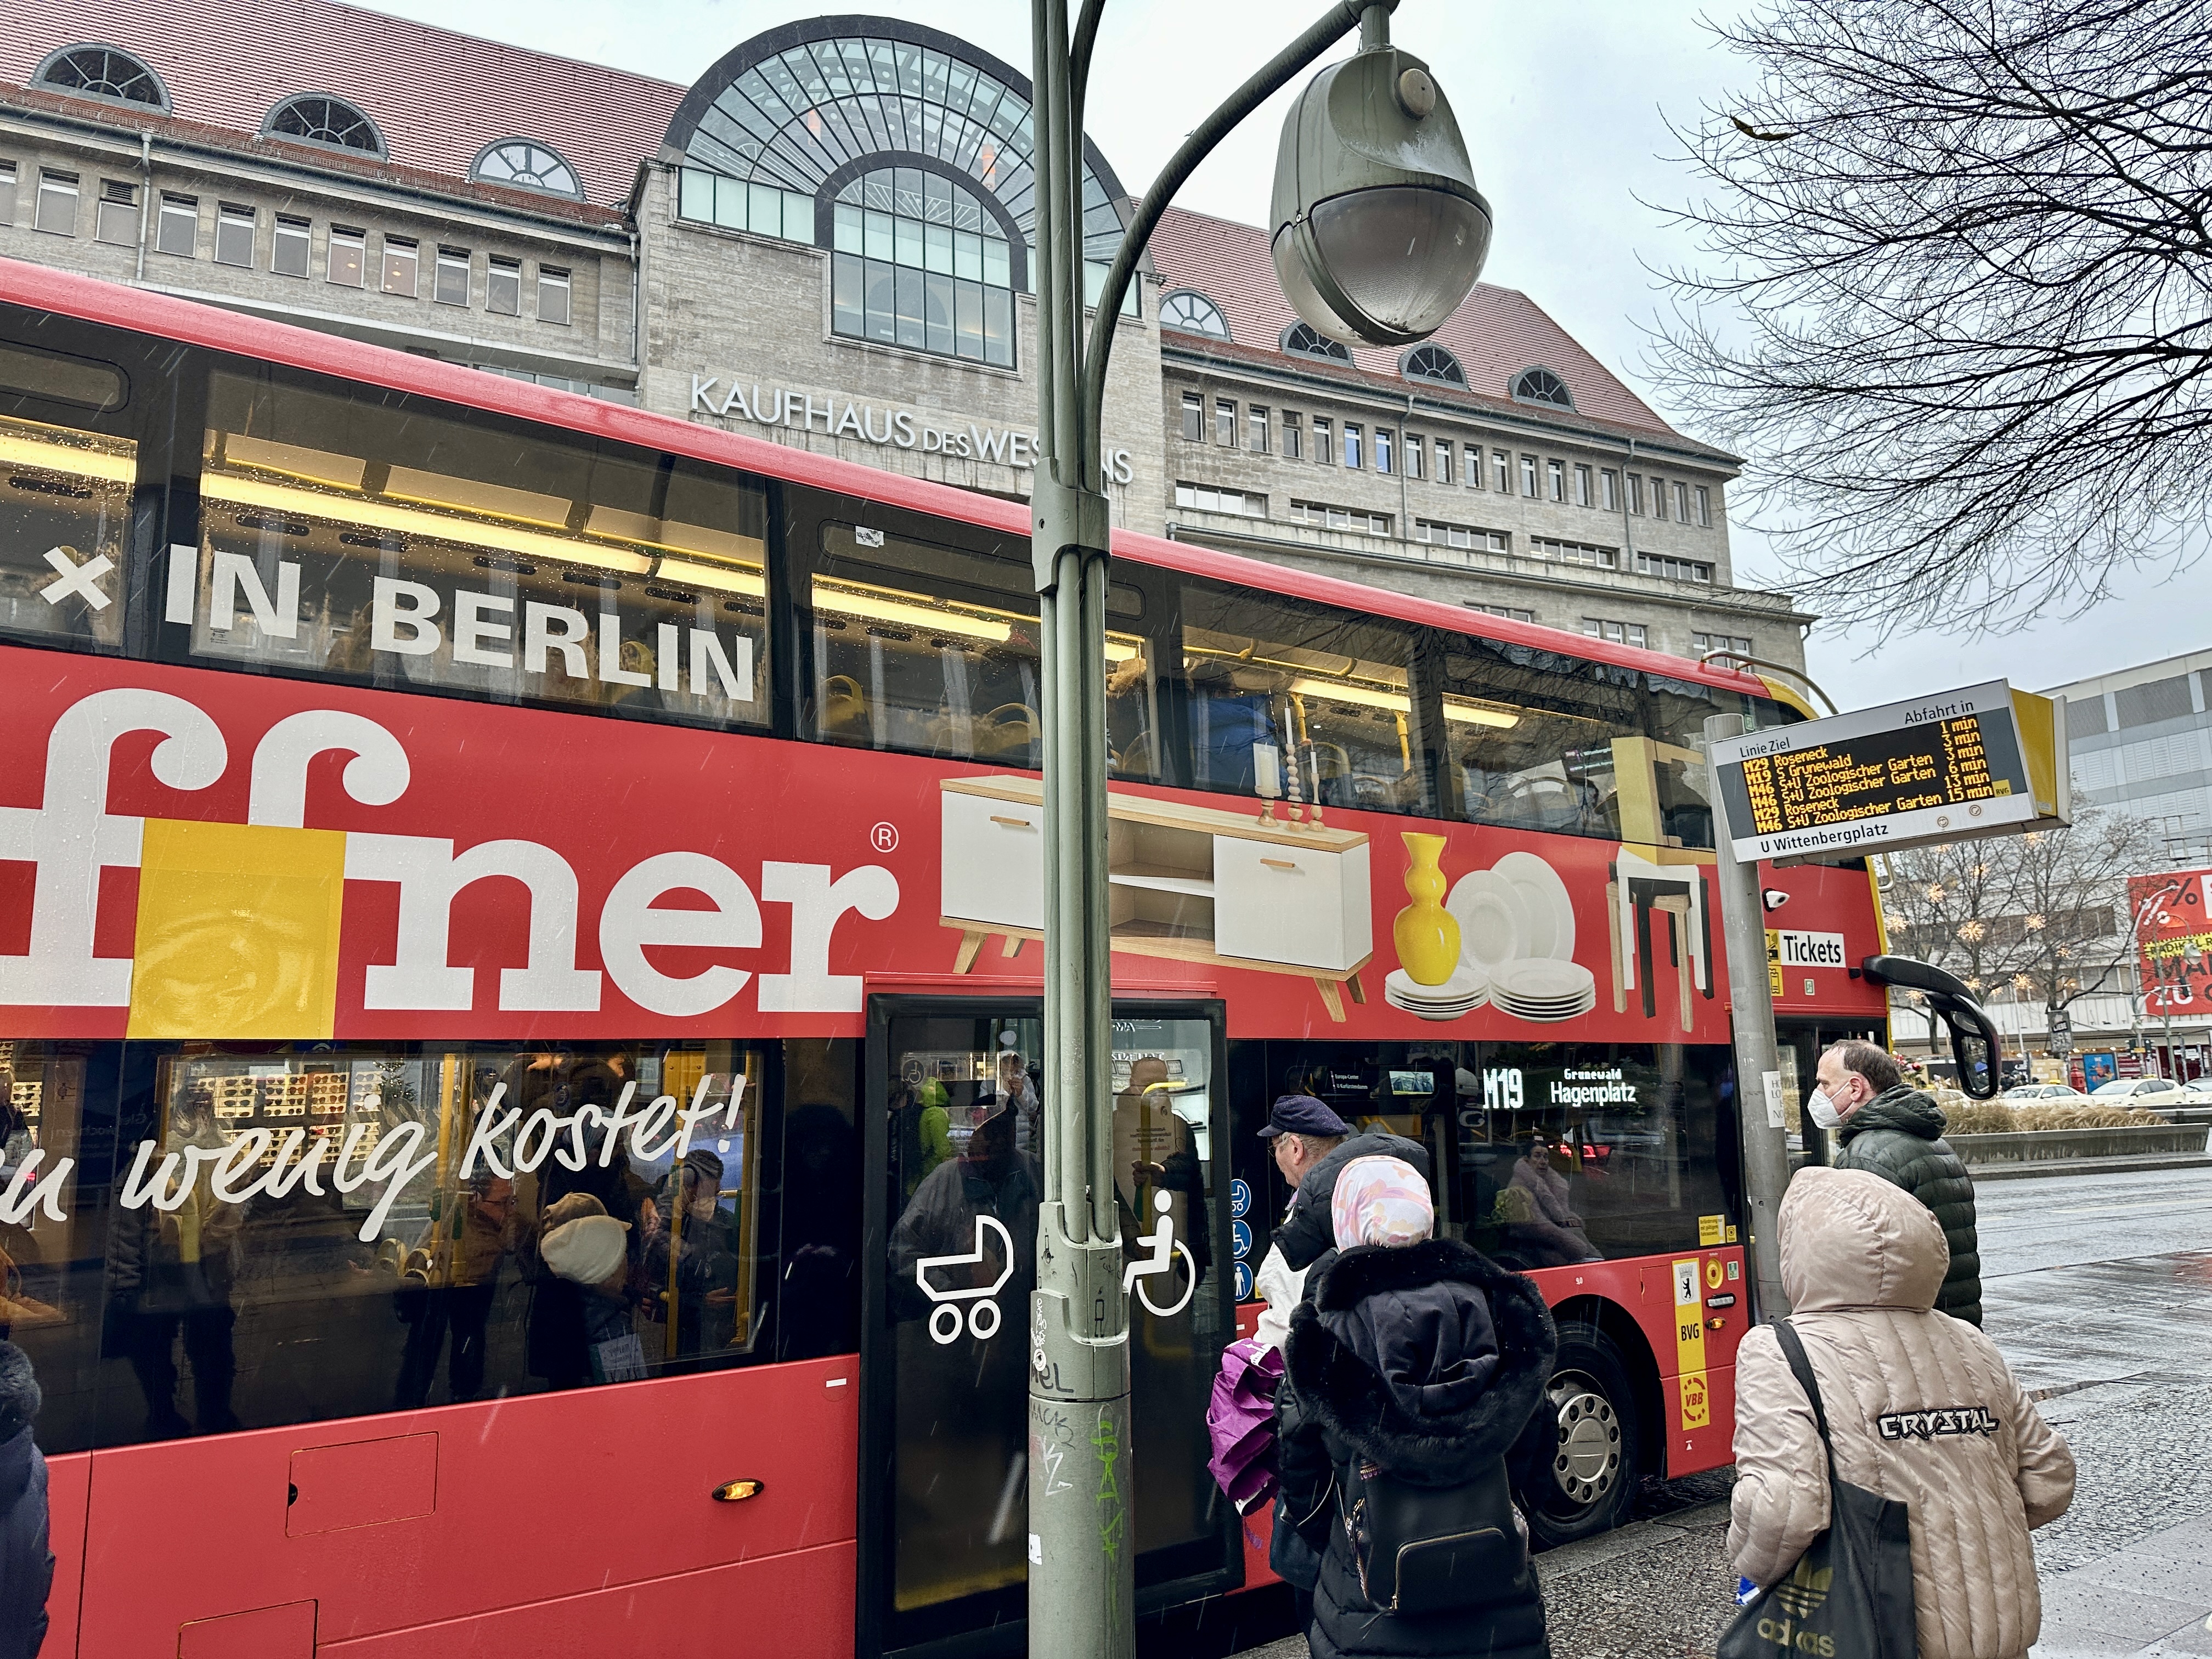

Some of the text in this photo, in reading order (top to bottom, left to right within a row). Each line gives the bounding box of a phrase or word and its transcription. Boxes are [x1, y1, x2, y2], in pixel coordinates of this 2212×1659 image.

[691, 373, 916, 448] KAUFHAUS
[922, 427, 971, 458] DES
[165, 543, 301, 639] IN
[371, 575, 753, 702] BERLIN
[1740, 700, 1974, 758] Linie Ziel Abfahrt in
[1743, 716, 1978, 773] M29 Roseneck 1 min
[1746, 730, 1980, 785] M19 S Grunewald 3 min
[1748, 743, 1983, 797] M46 S+U Zoologischer Garten 3 min
[1751, 757, 1987, 810] M46 S+U Zoologischer Garten 6 min
[1753, 771, 1990, 821] M29 Roseneck 13 min
[1756, 785, 1993, 833] M46 S+U Zoologischer Garten 15 min
[1760, 825, 1888, 853] U Wittenbergplatz
[1784, 935, 1841, 963] Tickets
[1483, 1068, 1523, 1109] M19
[1550, 1081, 1636, 1107] Hagenplatz
[1564, 1068, 1622, 1080] Grunewald
[120, 1094, 438, 1243] wenig
[459, 1074, 747, 1180] kostet!
[1681, 1323, 1699, 1341] BVG
[1685, 1392, 1703, 1407] VBB
[1876, 1407, 2000, 1440] CRYSTAL
